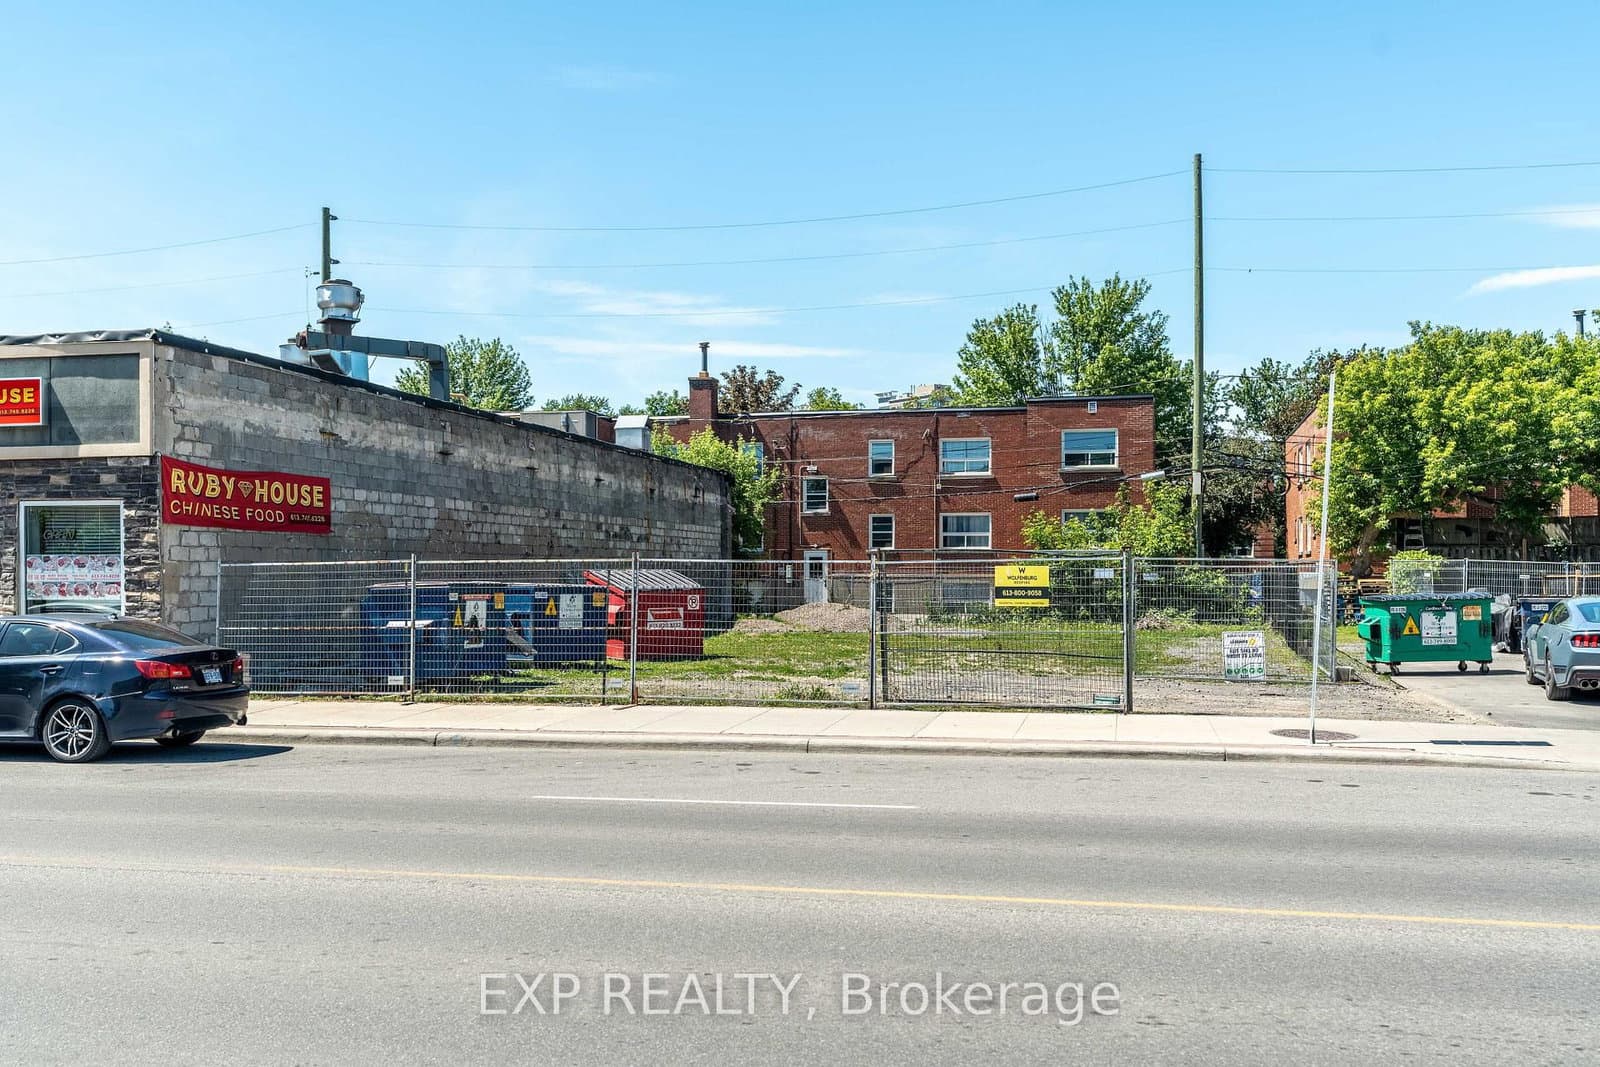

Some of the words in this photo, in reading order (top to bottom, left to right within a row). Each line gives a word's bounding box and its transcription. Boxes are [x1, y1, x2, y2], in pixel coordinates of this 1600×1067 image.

[171, 467, 236, 500] RUBY
[254, 479, 324, 508] HOUSE
[170, 500, 241, 520] CHINESE
[246, 508, 285, 523] FOOD
